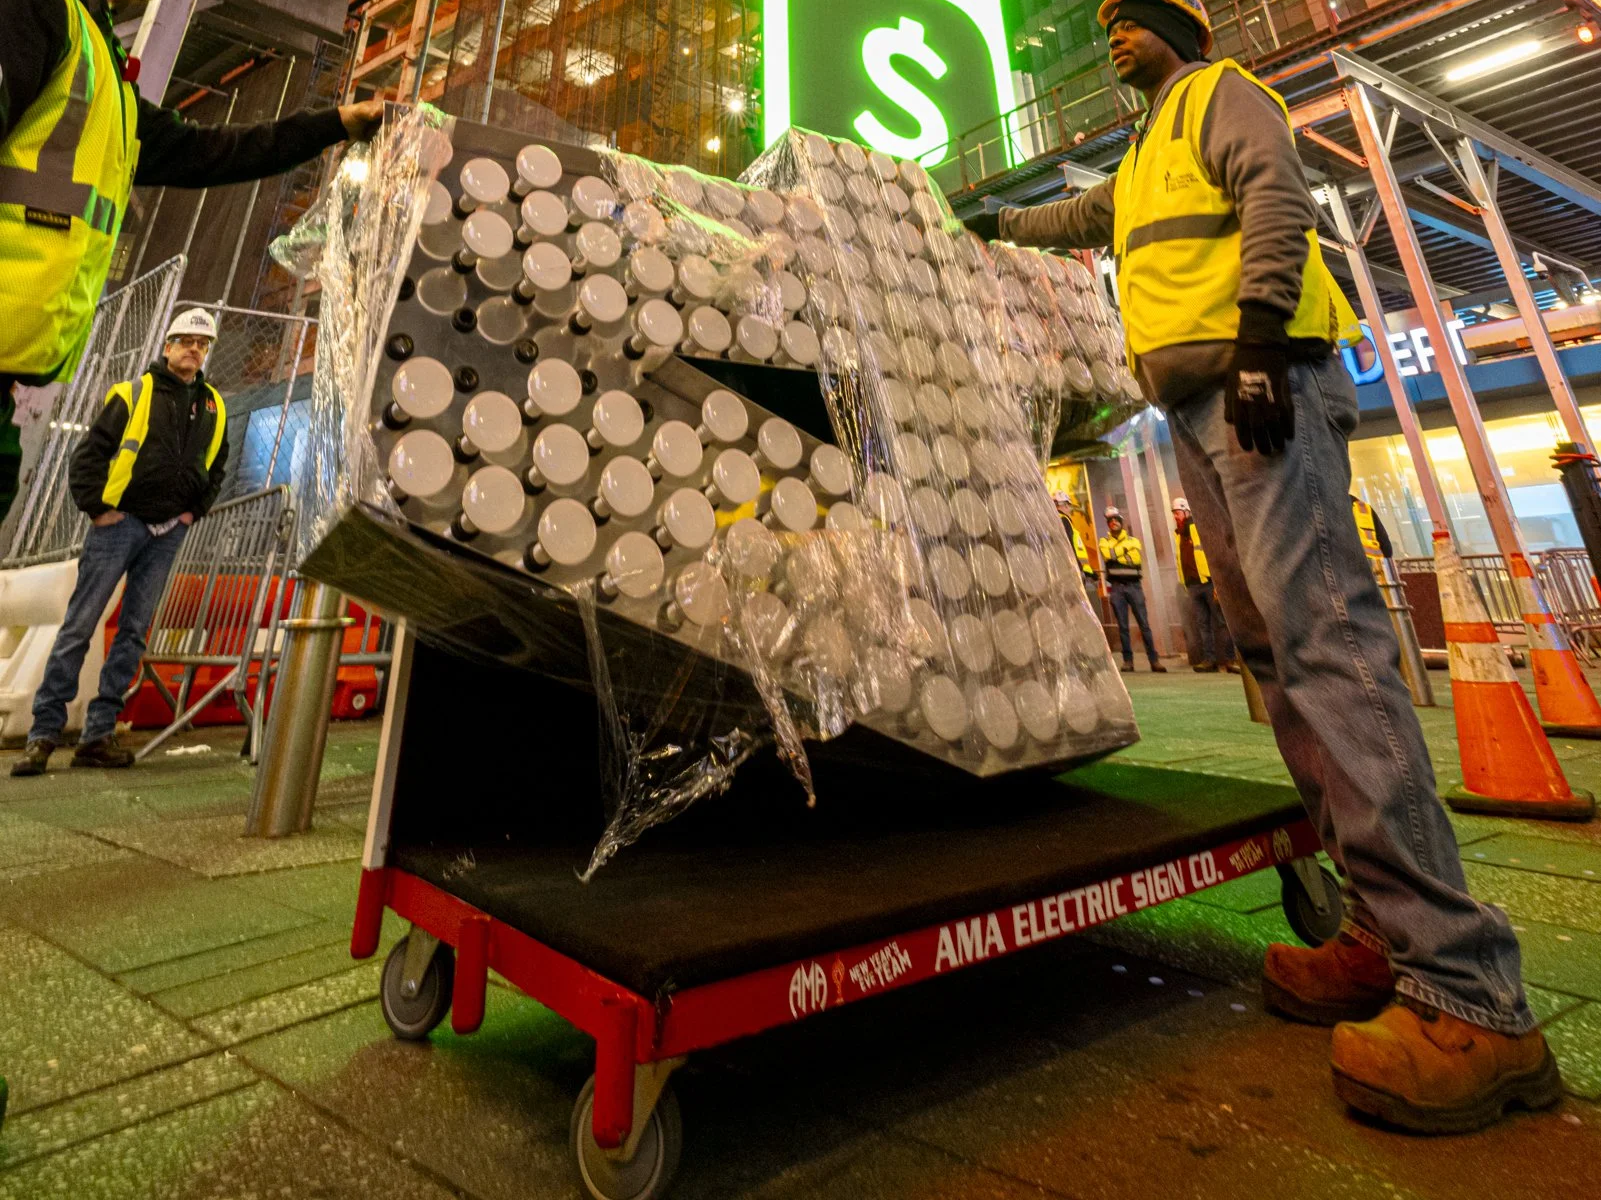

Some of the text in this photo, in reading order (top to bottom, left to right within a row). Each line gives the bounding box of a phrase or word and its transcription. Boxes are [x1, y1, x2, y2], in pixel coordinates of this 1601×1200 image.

[1341, 319, 1467, 386] DEPT
[934, 850, 1224, 972] AMA ELECTRIC SIGN CO.
[789, 960, 828, 1020] AMA
[848, 959, 870, 985] NEW
[872, 948, 913, 987] TEAM
